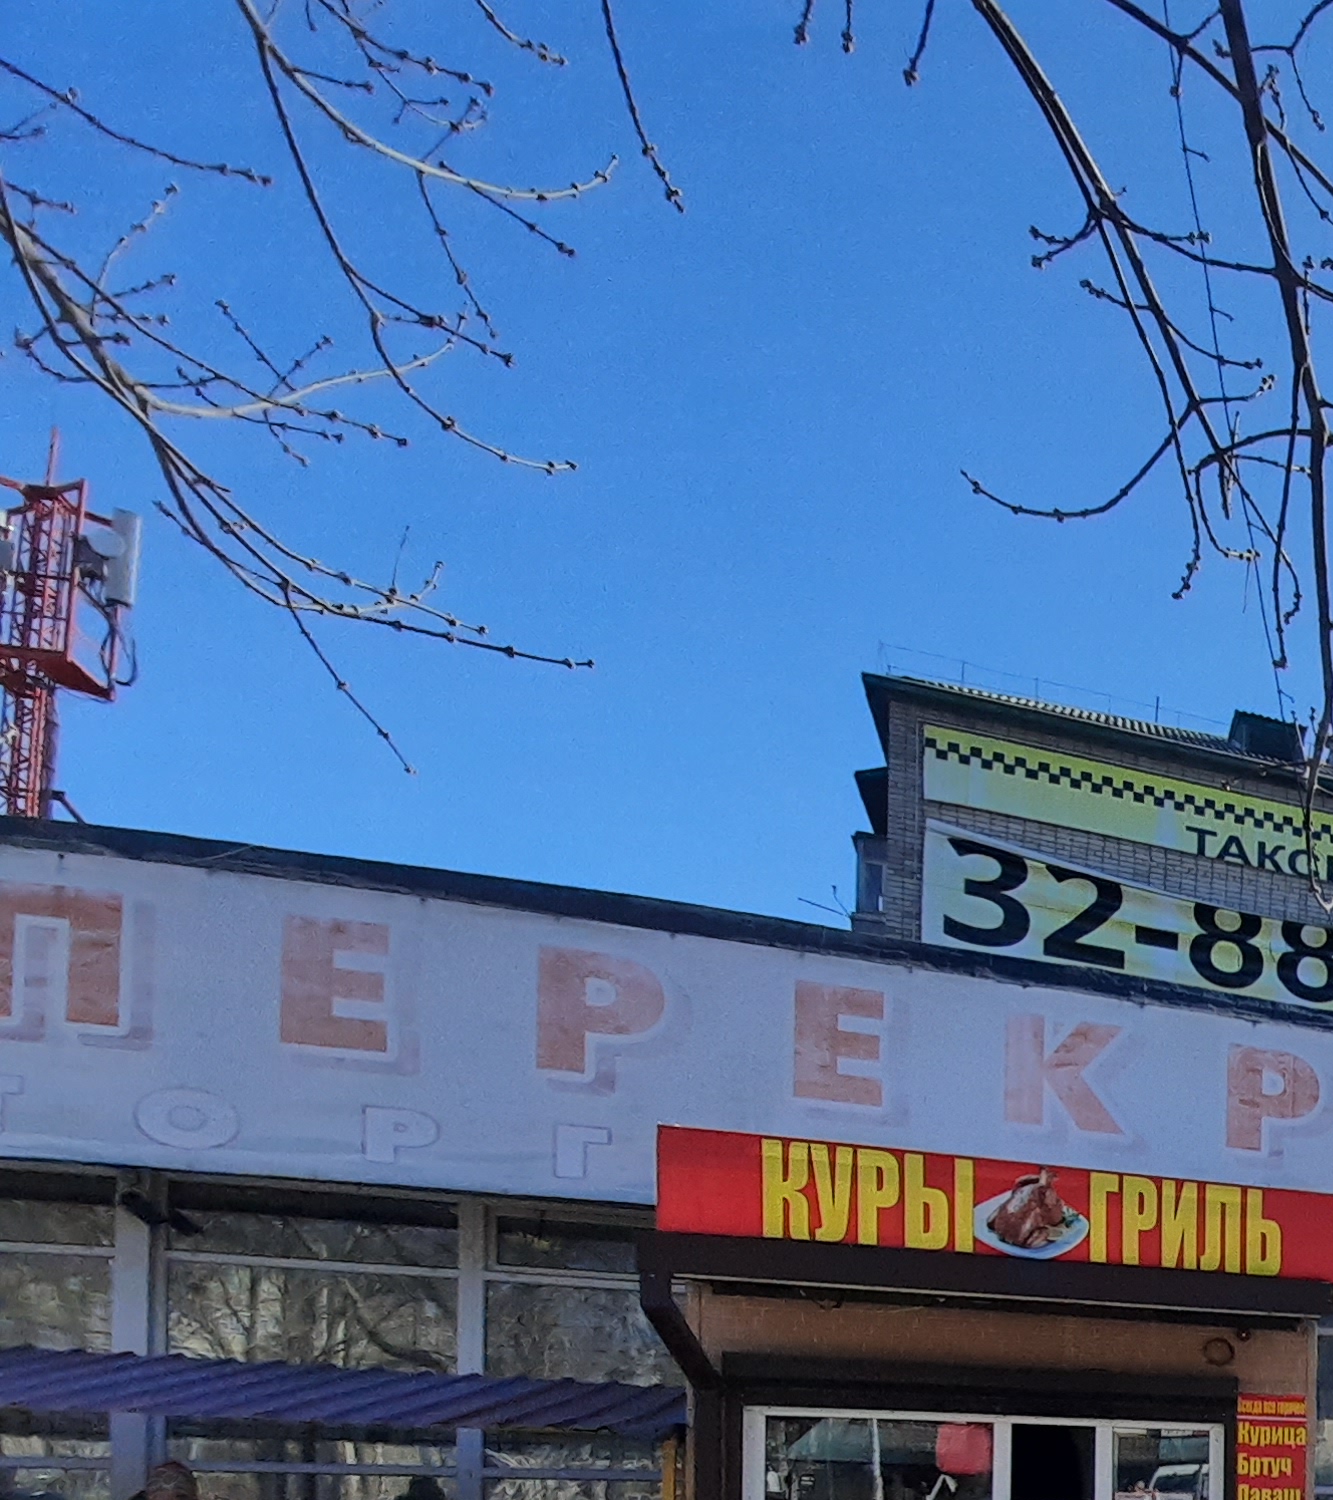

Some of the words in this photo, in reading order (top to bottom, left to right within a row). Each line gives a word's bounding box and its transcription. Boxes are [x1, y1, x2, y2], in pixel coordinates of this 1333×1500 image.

[761, 1138, 975, 1253] КУРЫ
[1089, 1171, 1282, 1276] ГРИЛЬ
[1238, 1421, 1307, 1449] Курица
[1237, 1452, 1292, 1478] Бртуч
